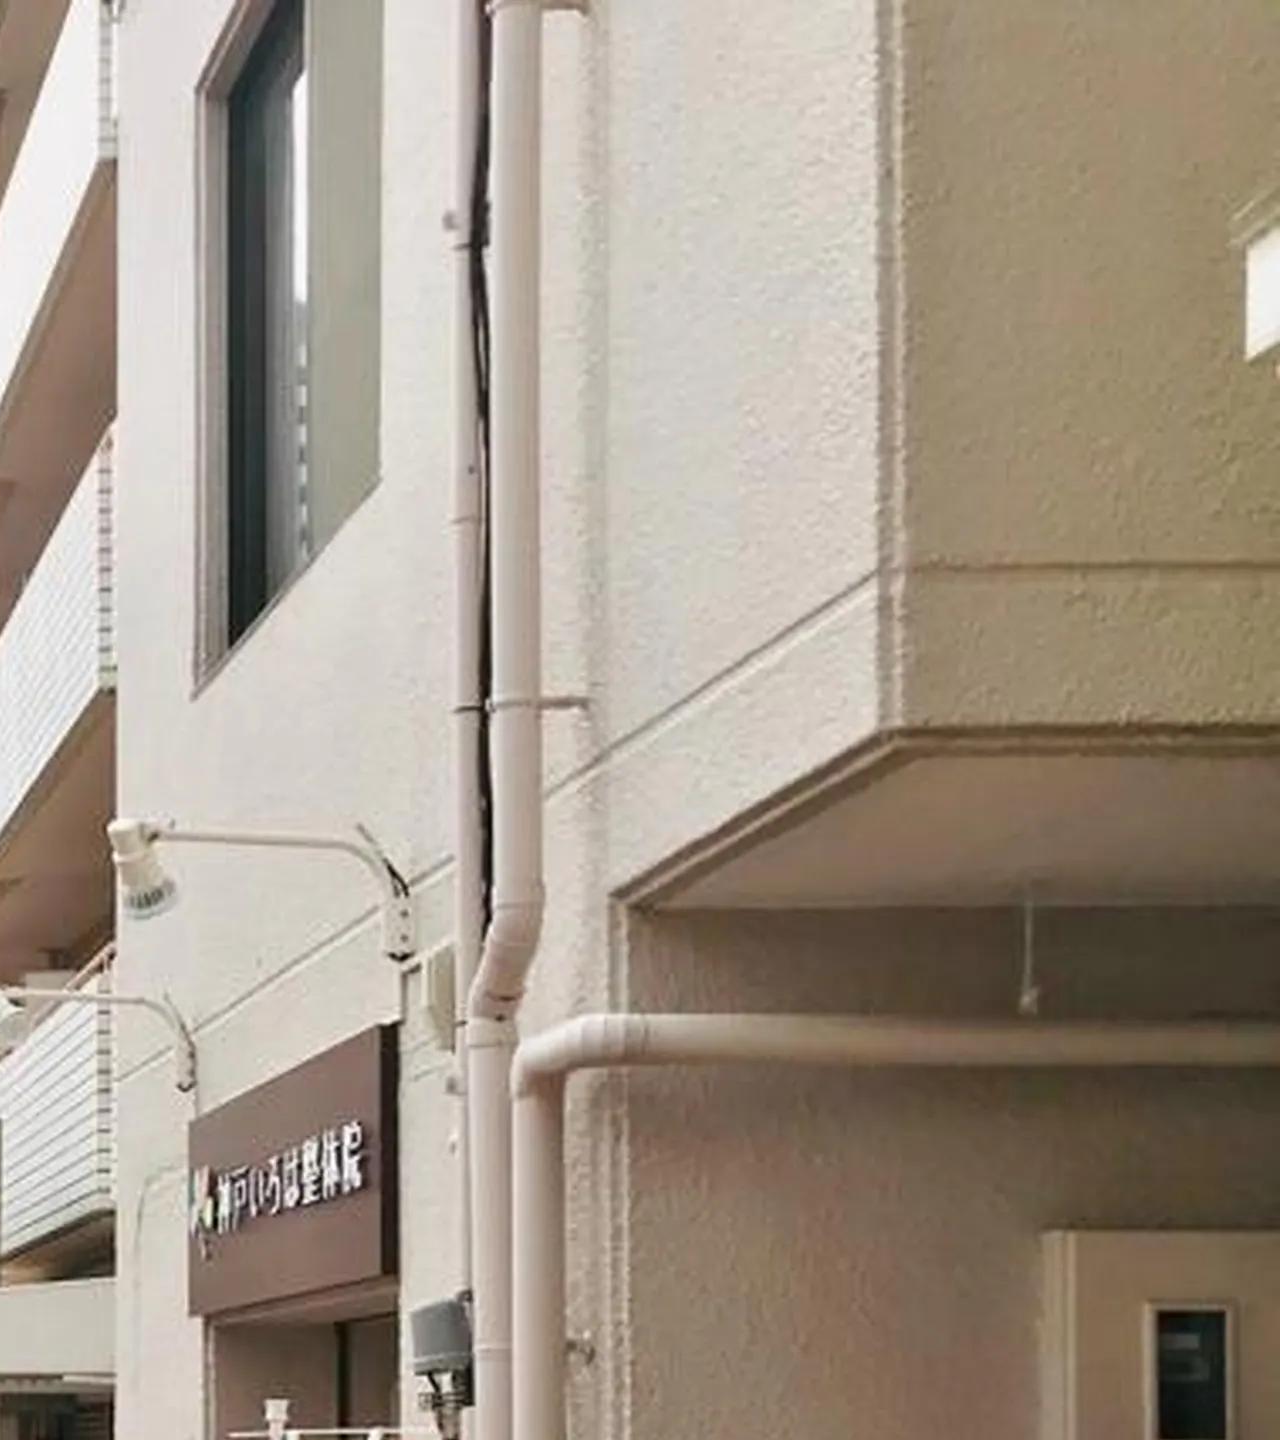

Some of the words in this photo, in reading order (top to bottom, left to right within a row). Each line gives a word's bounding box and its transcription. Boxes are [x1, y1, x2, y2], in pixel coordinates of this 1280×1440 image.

[216, 1121, 363, 1234] 神戸いろは整体院
